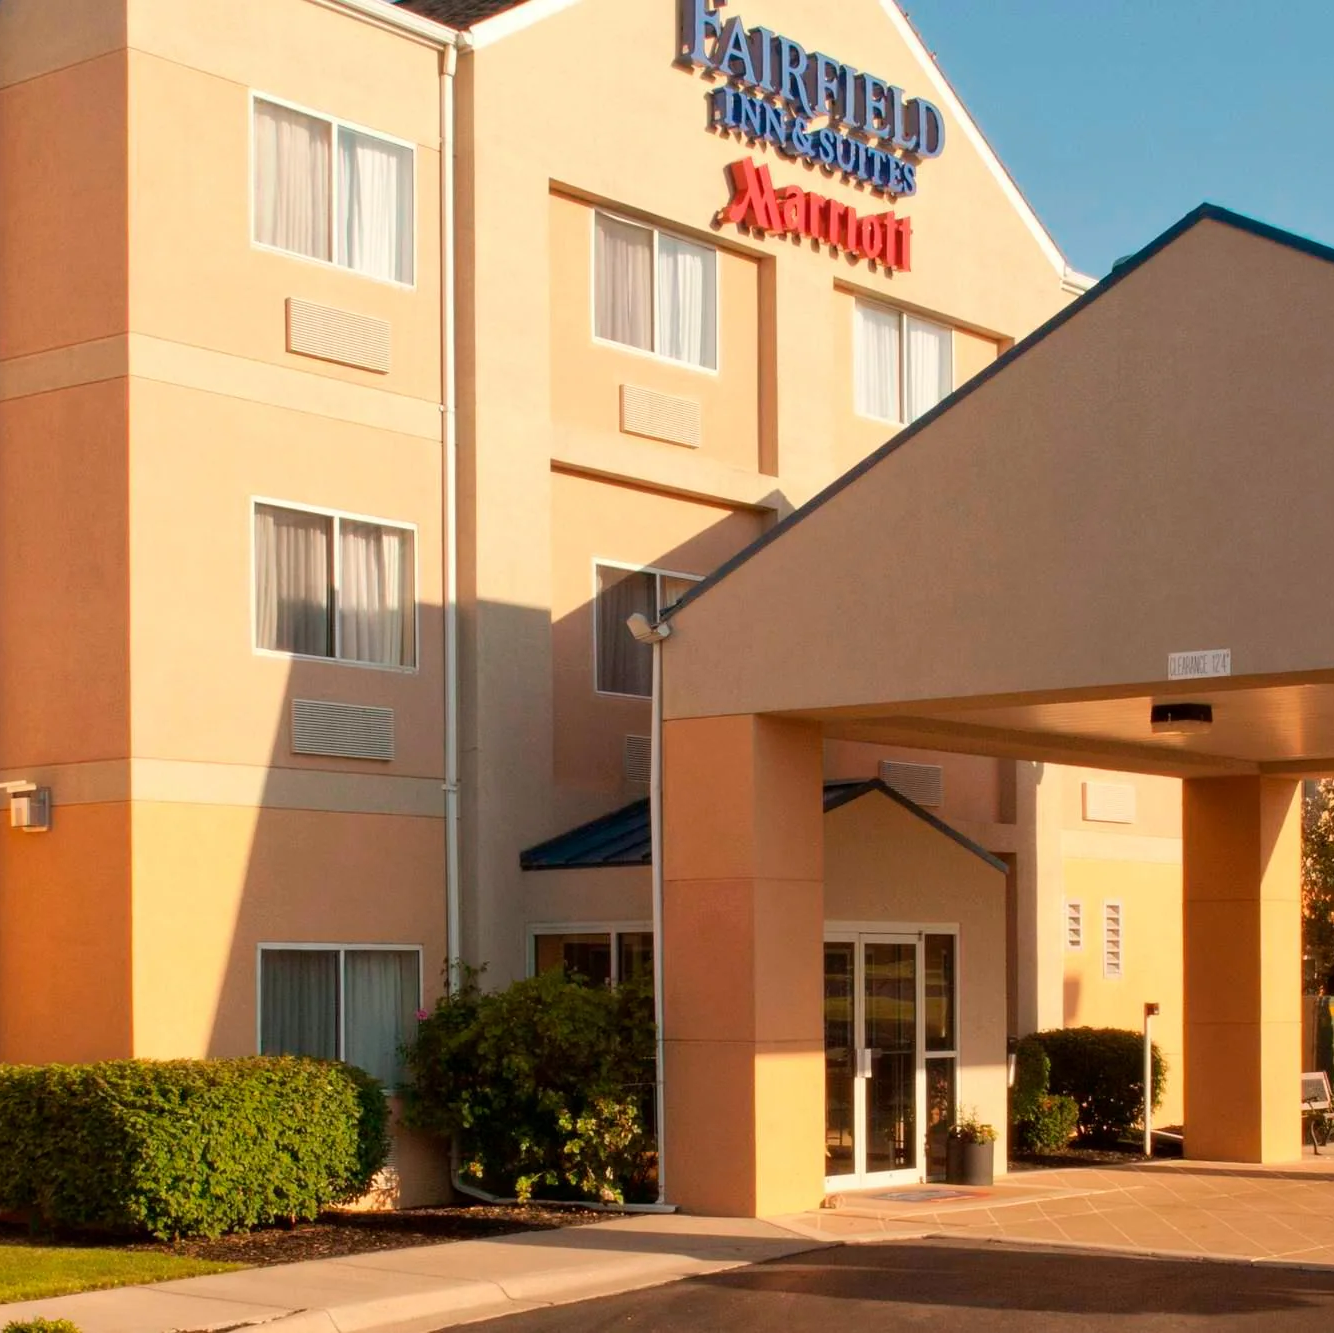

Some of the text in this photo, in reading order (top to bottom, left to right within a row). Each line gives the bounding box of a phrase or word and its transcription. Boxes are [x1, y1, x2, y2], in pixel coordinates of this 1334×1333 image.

[687, 0, 946, 159] FAIRFIELD
[722, 86, 917, 197] INN & SUITES
[728, 156, 912, 273] Marriott
